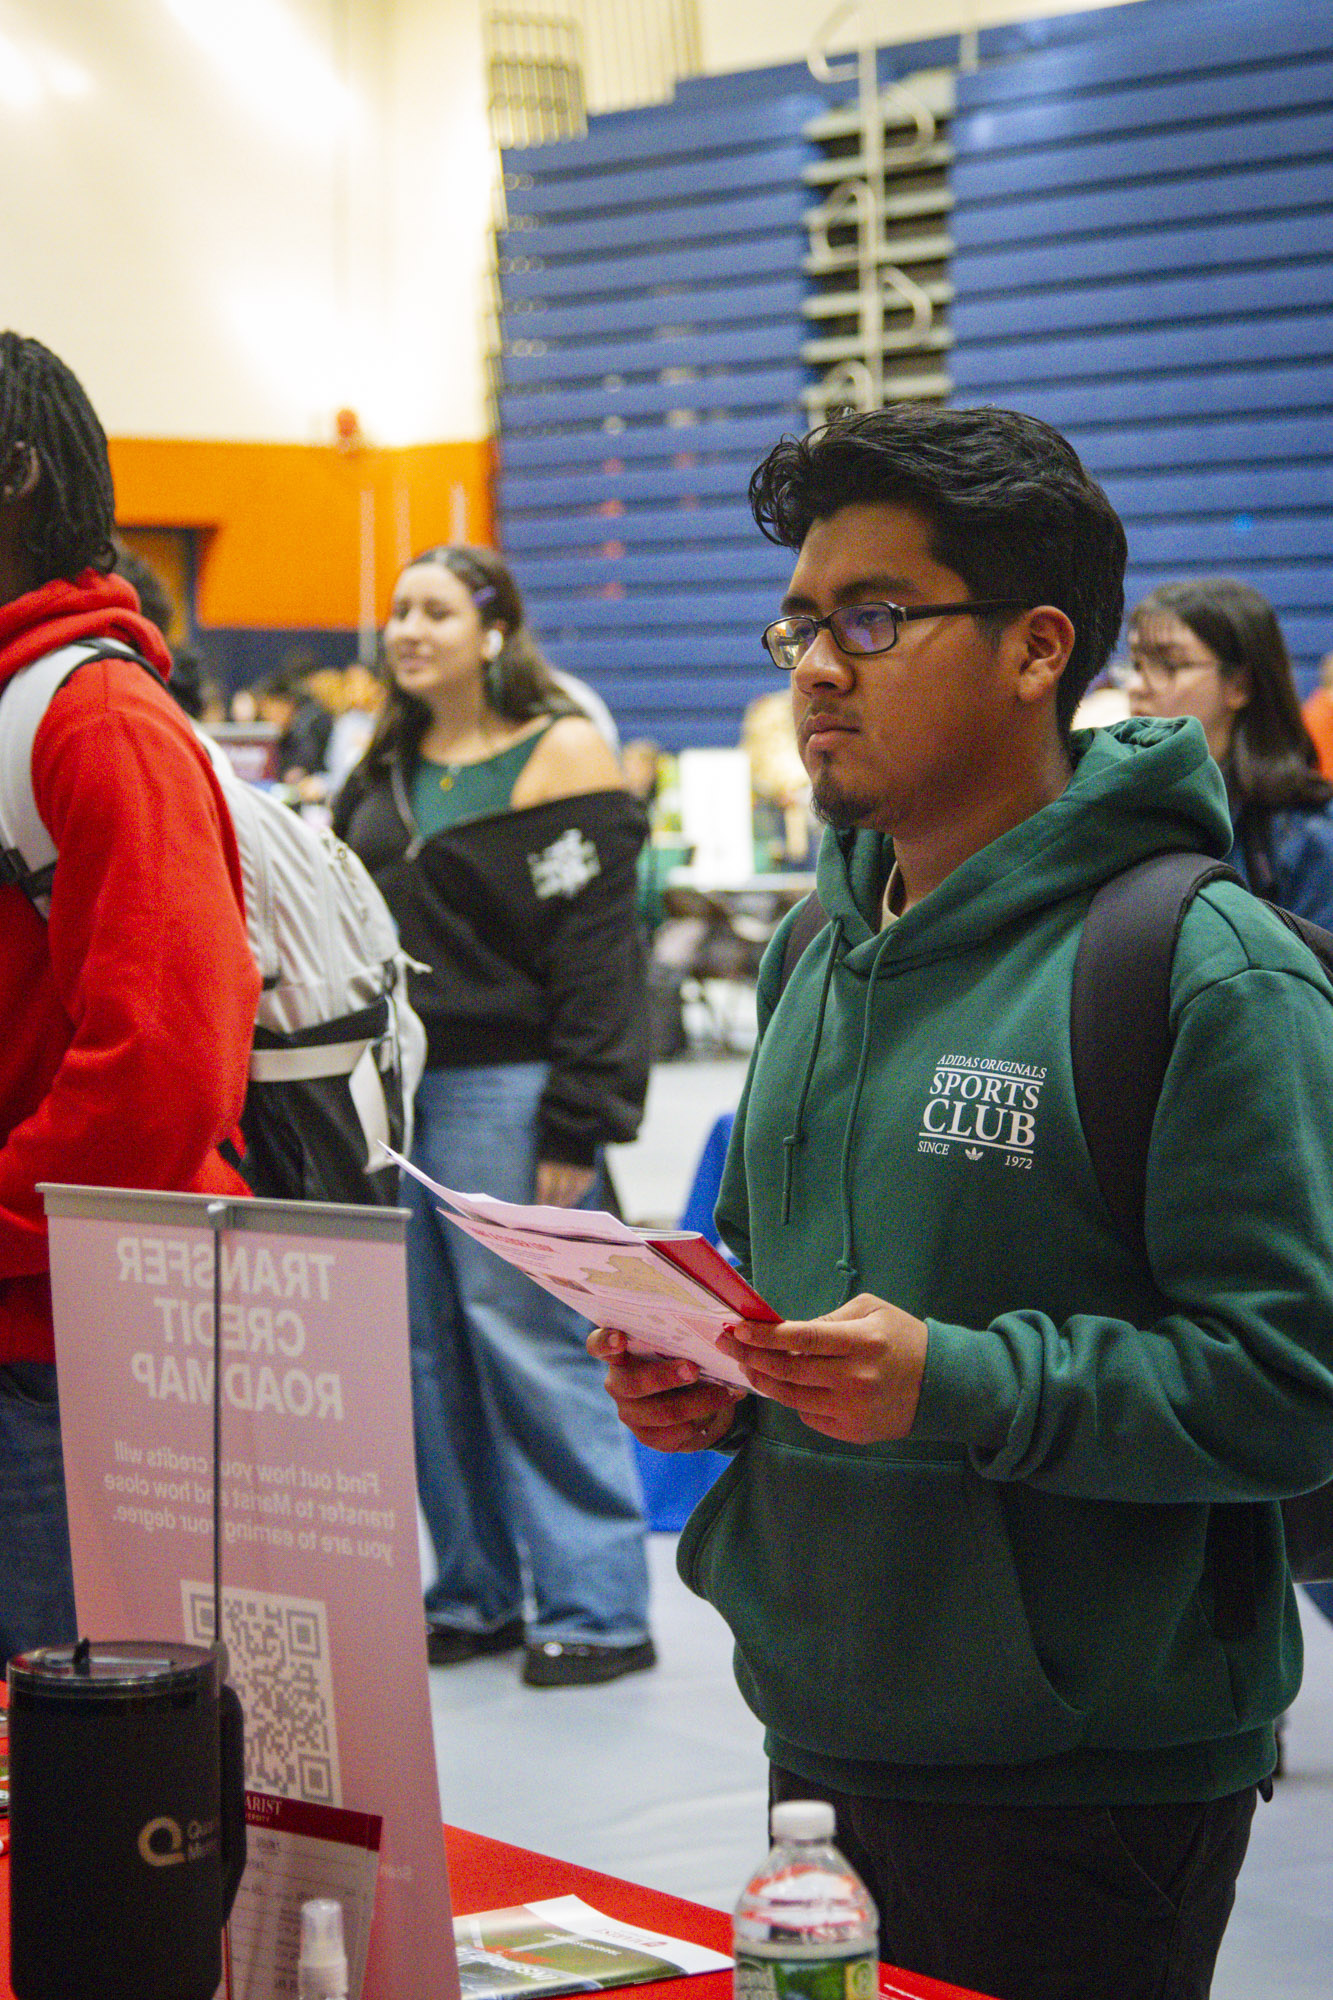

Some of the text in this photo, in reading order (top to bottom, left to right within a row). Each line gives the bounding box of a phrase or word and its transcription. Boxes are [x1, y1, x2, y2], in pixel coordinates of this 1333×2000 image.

[938, 1055, 1047, 1078] ADIDAS ORIGINALS
[929, 1072, 1040, 1110] SPORTS
[923, 1098, 1036, 1146] CLUB
[918, 1141, 1033, 1169] SINCE 1972
[246, 1795, 282, 1815] ARIST
